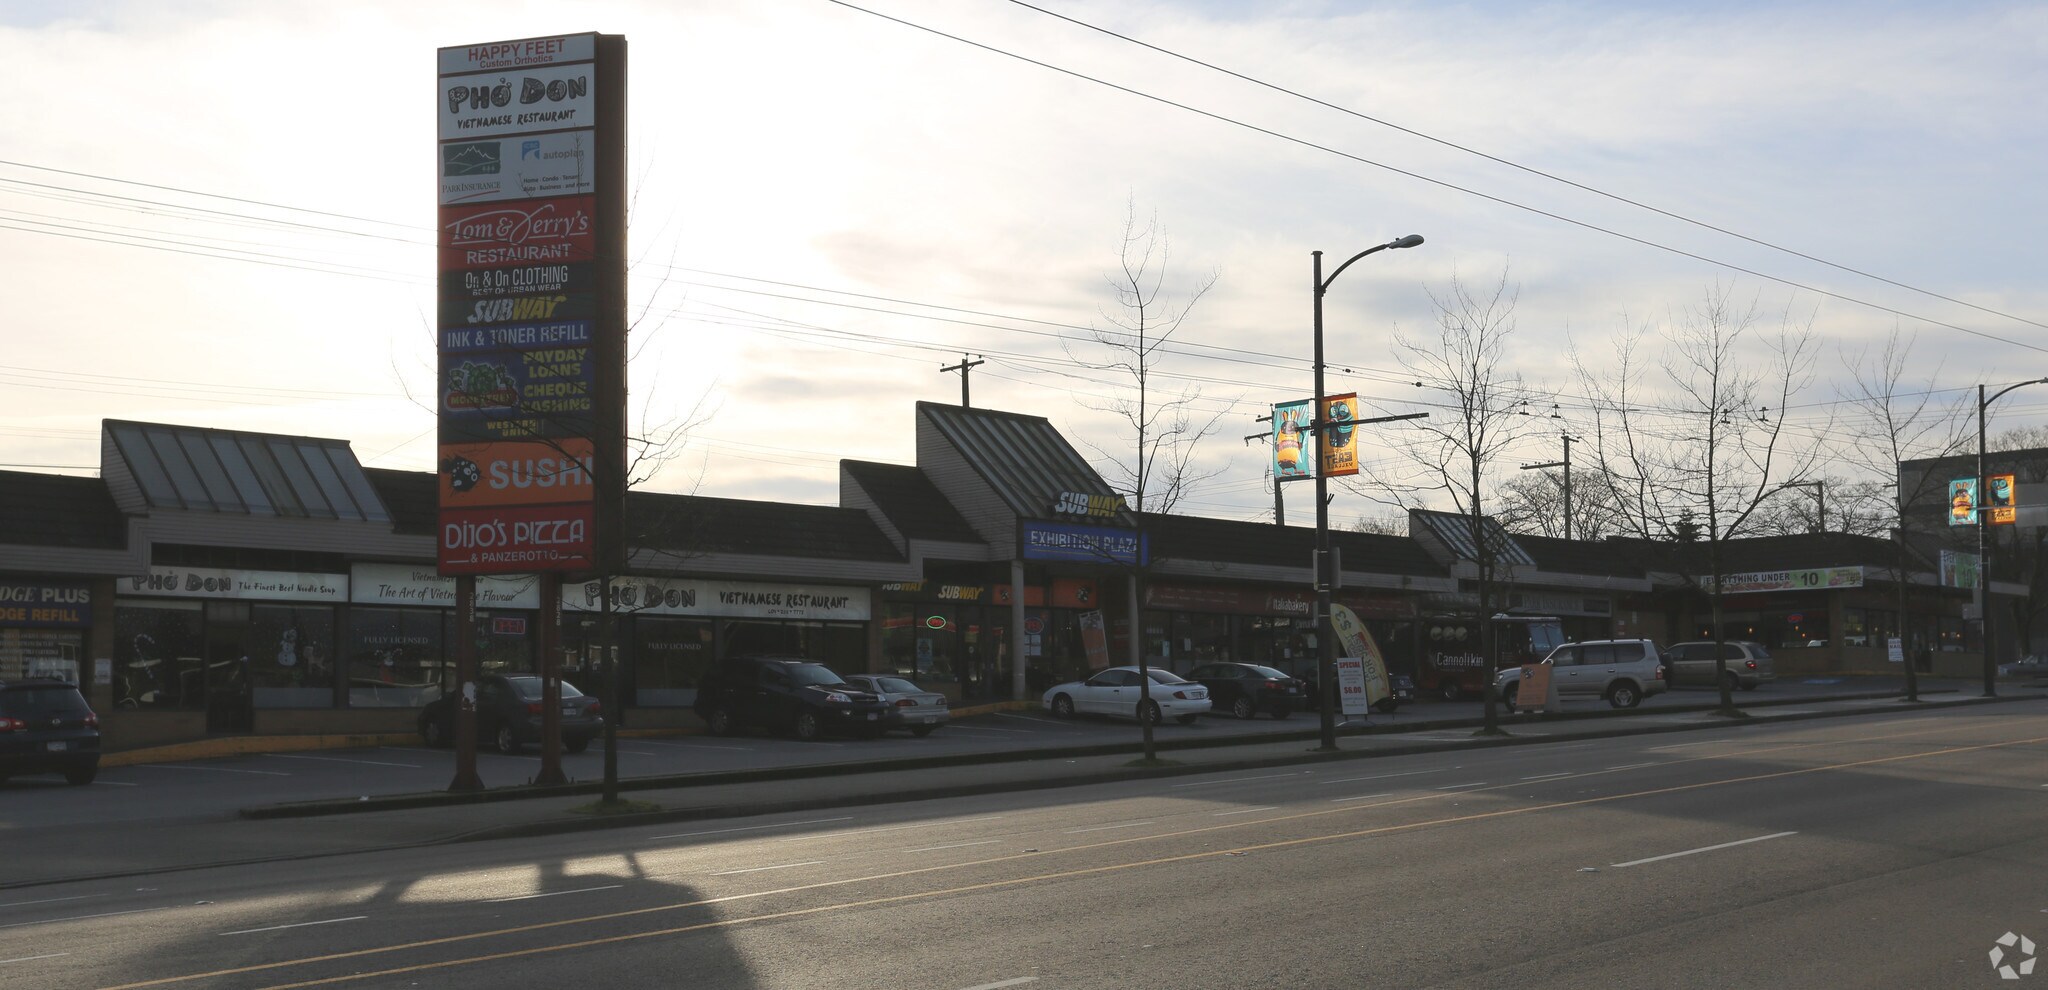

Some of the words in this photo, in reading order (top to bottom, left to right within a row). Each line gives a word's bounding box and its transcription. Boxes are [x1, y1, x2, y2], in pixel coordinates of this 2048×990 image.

[468, 43, 522, 61] HAPPY
[525, 38, 567, 55] FEET
[480, 59, 512, 69] Custom
[514, 54, 554, 66] Orthotics
[520, 76, 587, 104] DON
[457, 114, 513, 130] VIETNAMESE
[517, 109, 577, 125] RESTAURANT
[543, 149, 585, 160] autoplan
[446, 210, 495, 242] Tom
[510, 204, 589, 246] Jerry's
[467, 243, 572, 265] RESTAURANT
[465, 272, 480, 290] On
[483, 270, 493, 288] &
[495, 269, 510, 287] On
[512, 265, 569, 286] CLOTHING
[508, 284, 536, 293] URBAN
[538, 282, 562, 292] WEAR
[467, 295, 567, 325] SUBWAY
[447, 330, 471, 349] INK
[475, 329, 486, 347] &
[490, 326, 536, 346] TONER
[540, 323, 589, 344] REFILL
[523, 347, 588, 365] PAYDAY
[529, 362, 582, 379] LOANS
[524, 380, 589, 398] CHEQUE
[489, 456, 594, 490] SUSHI
[1054, 491, 1127, 518] SUBWAY
[1031, 531, 1099, 551] EXHIBITION
[470, 553, 479, 564] &
[185, 573, 232, 592] DON
[239, 582, 253, 591] The
[254, 582, 276, 592] Finest
[278, 582, 295, 592] Beef
[296, 583, 318, 594] Noodle
[320, 584, 336, 596] Soup
[1761, 571, 1791, 582] UNDER
[41, 587, 91, 604] PLUS
[379, 583, 397, 599] The
[398, 586, 414, 599] Art
[416, 586, 428, 605] of
[482, 588, 518, 603] Flavour
[644, 583, 696, 608] DON
[720, 591, 782, 606] VIETNAMESE
[786, 594, 849, 610] RESTAURANT
[938, 585, 984, 600] SUBWAY
[32, 608, 80, 622] REFILL
[364, 634, 389, 644] FULLY
[391, 635, 429, 645] LICENSED
[648, 641, 670, 651] FULLY
[671, 642, 702, 651] LICENSED
[1436, 651, 1484, 667] Cannolikin
